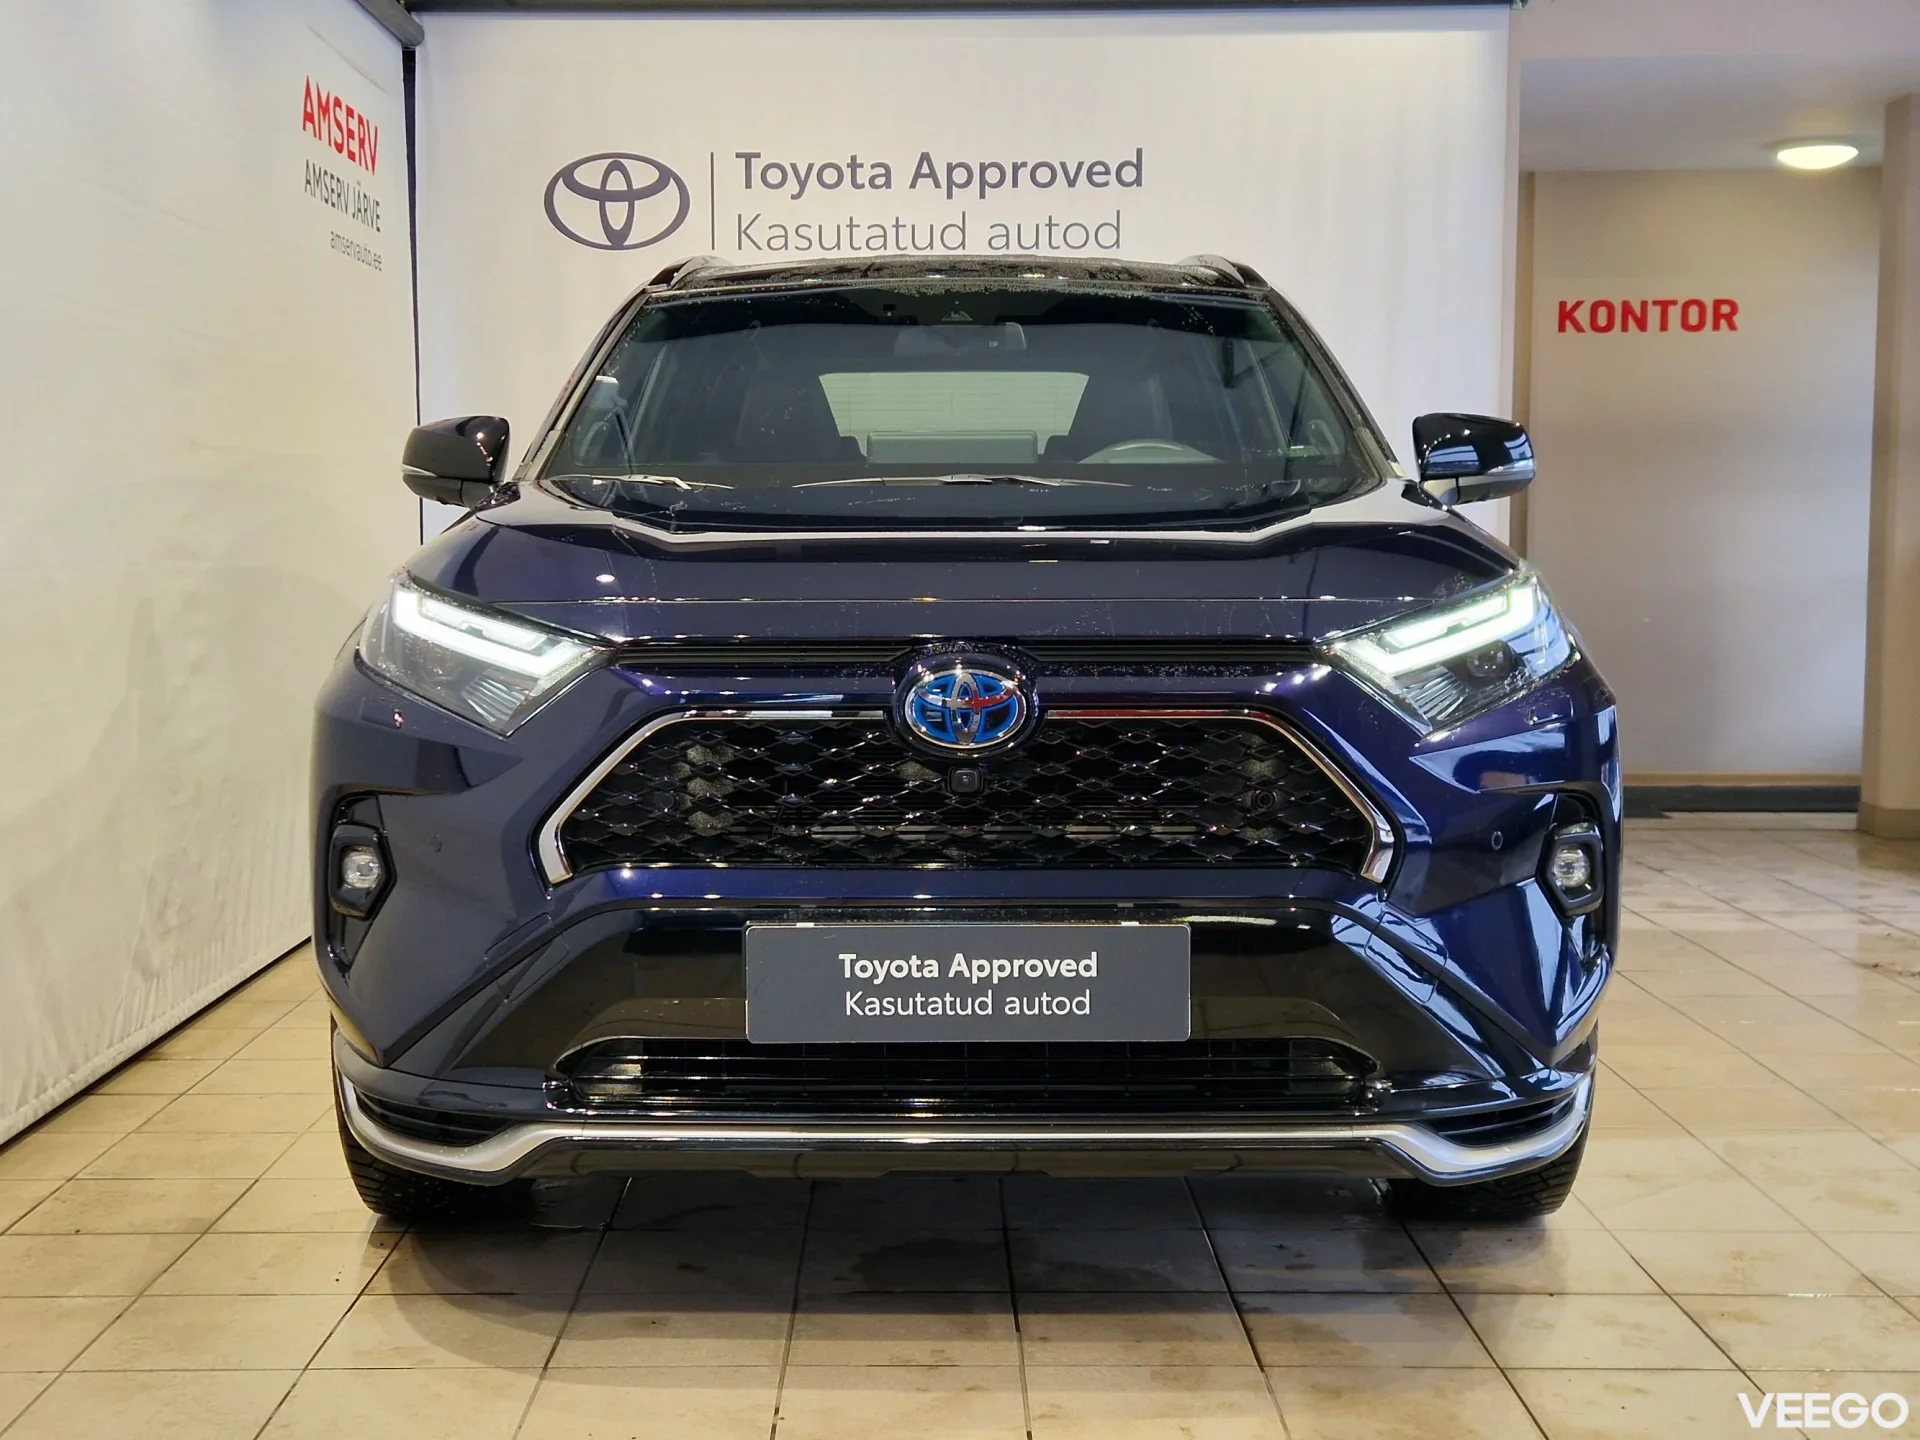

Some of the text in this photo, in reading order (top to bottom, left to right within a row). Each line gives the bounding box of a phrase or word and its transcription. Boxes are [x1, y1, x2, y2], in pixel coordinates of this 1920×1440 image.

[302, 74, 379, 176] AMSERV
[735, 148, 1144, 200] Toyota Approved
[304, 159, 381, 232] AMSERV JÄRVE
[736, 210, 1122, 252] Kasutatud autod
[1557, 298, 1739, 334] KONTOR
[838, 951, 1098, 984] Toyota Approved
[845, 989, 1091, 1016] Kasutatud autod
